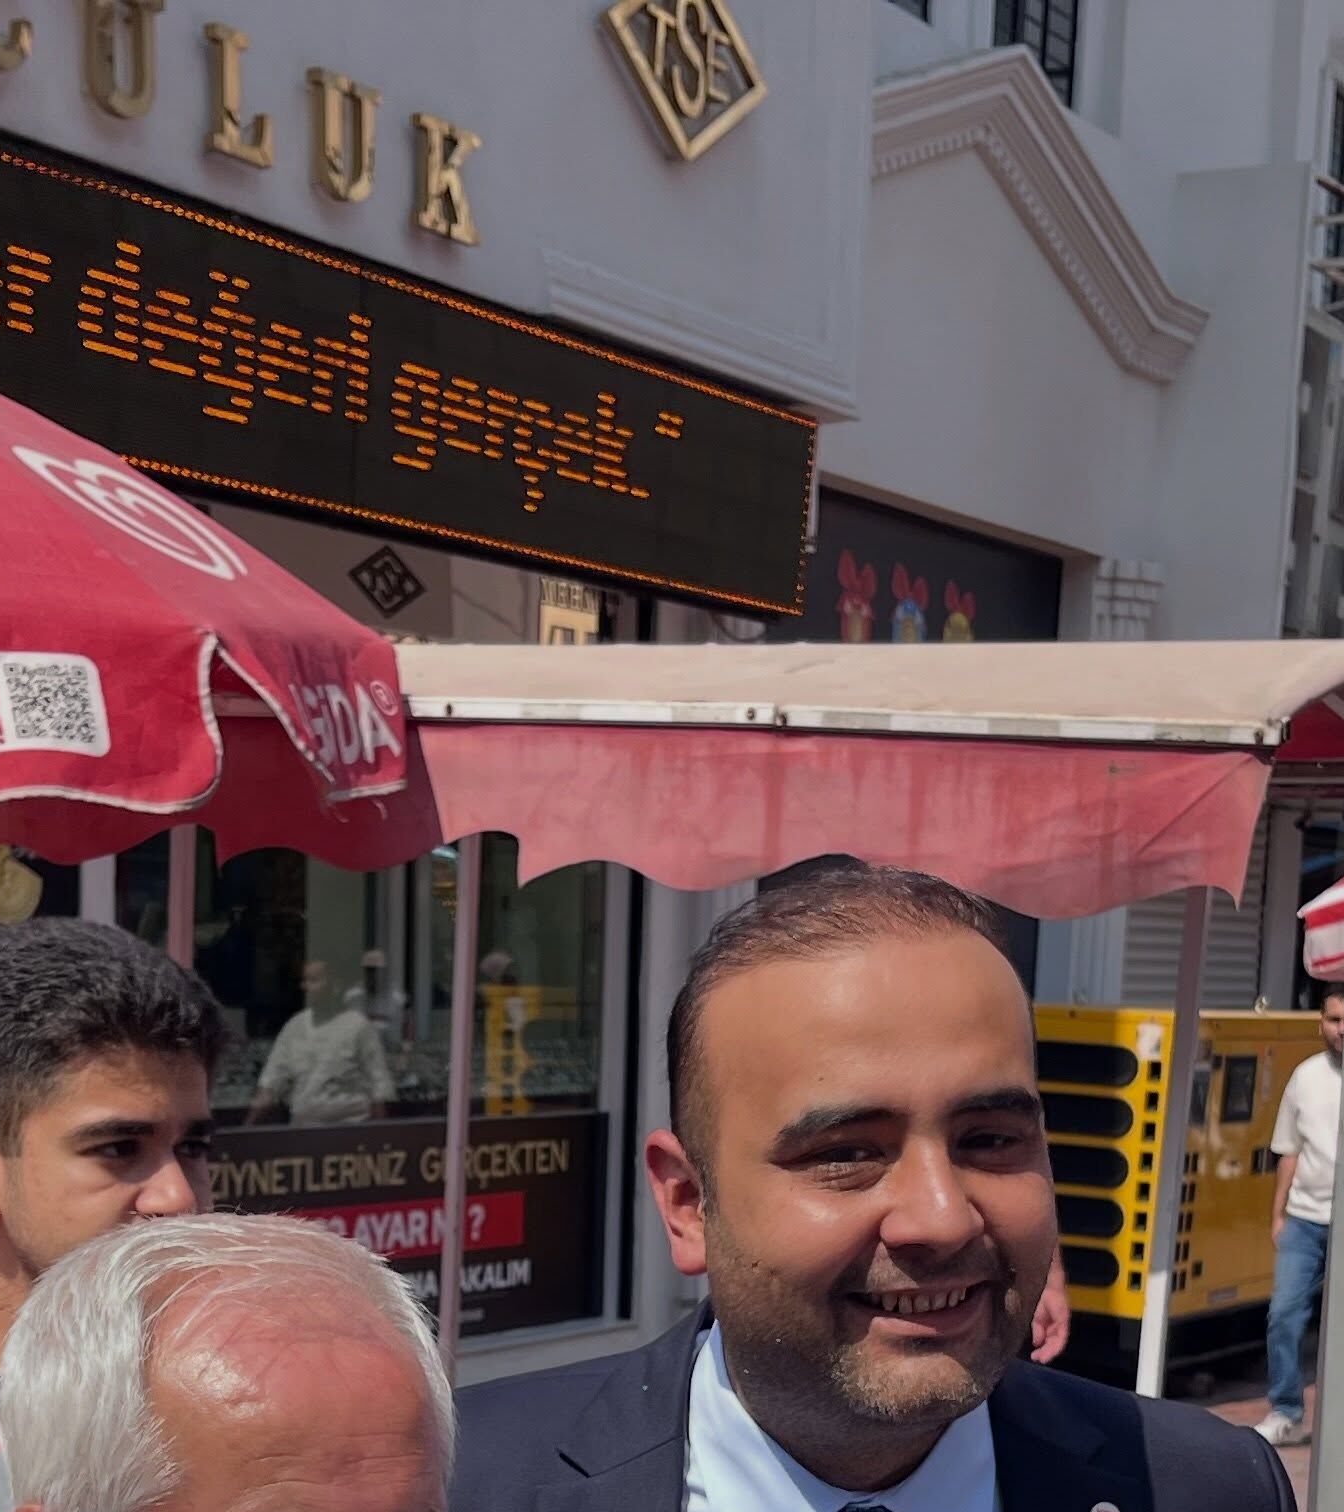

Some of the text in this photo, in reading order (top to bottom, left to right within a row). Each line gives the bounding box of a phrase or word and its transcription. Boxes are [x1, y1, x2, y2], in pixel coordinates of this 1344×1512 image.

[420, 1139, 570, 1190] GRÇEKTEN
[355, 1210, 427, 1250] AYAR
[459, 1257, 532, 1292] AKALIM
